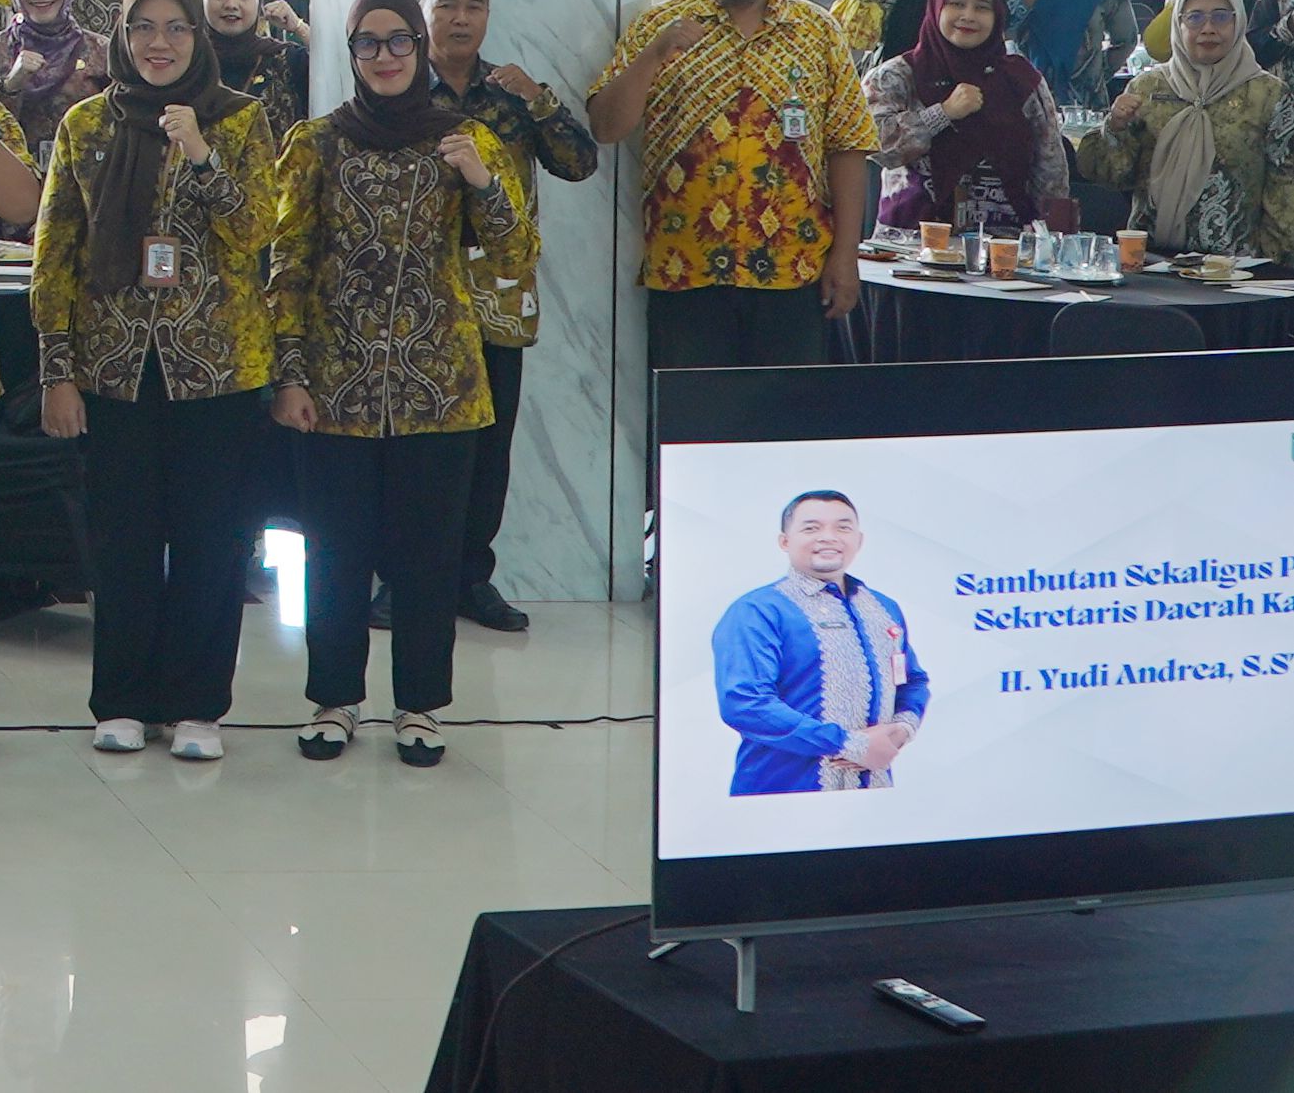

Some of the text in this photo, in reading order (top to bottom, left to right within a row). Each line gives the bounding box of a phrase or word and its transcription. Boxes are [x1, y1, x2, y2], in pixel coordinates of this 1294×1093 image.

[956, 568, 1118, 596] Sambutan
[1125, 558, 1273, 589] Sekaligus
[974, 600, 1138, 631] Sekretaris
[1145, 593, 1254, 622] Daerah
[999, 653, 1294, 693] H. Yudi Andrea, S.S
